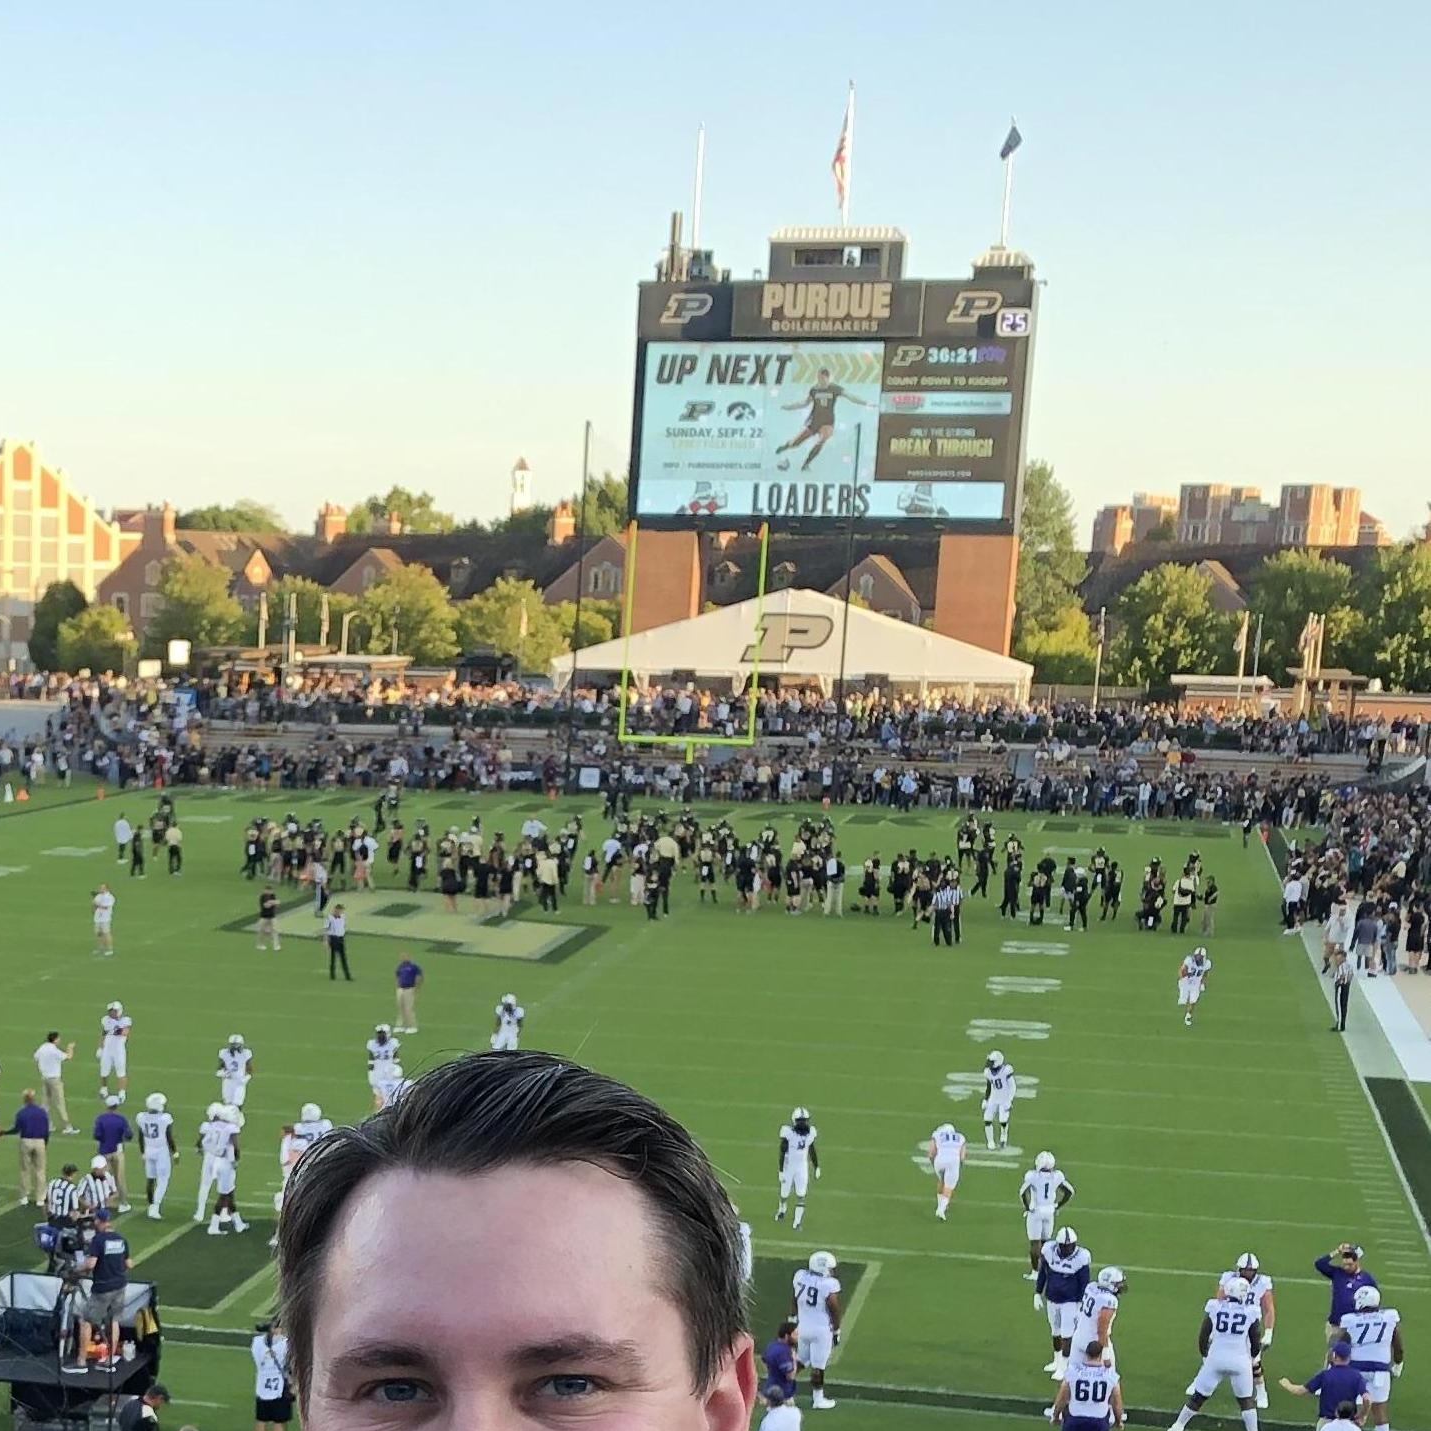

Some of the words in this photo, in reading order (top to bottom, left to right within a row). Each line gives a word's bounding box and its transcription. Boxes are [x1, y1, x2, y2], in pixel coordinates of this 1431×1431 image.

[761, 282, 892, 319] PURDUE
[771, 320, 878, 332] BOILERMAKERS
[656, 354, 698, 385] UP
[706, 354, 793, 385] NEXT
[665, 427, 714, 439] SUNDAY,
[717, 427, 746, 438] SEPT.
[750, 427, 763, 438] 22
[937, 438, 993, 458] THROUGH
[752, 482, 872, 517] LOADERS
[796, 1281, 819, 1307] 79
[1215, 1311, 1247, 1335] 62
[1355, 1321, 1387, 1344] 77
[1075, 1379, 1107, 1402] 60
